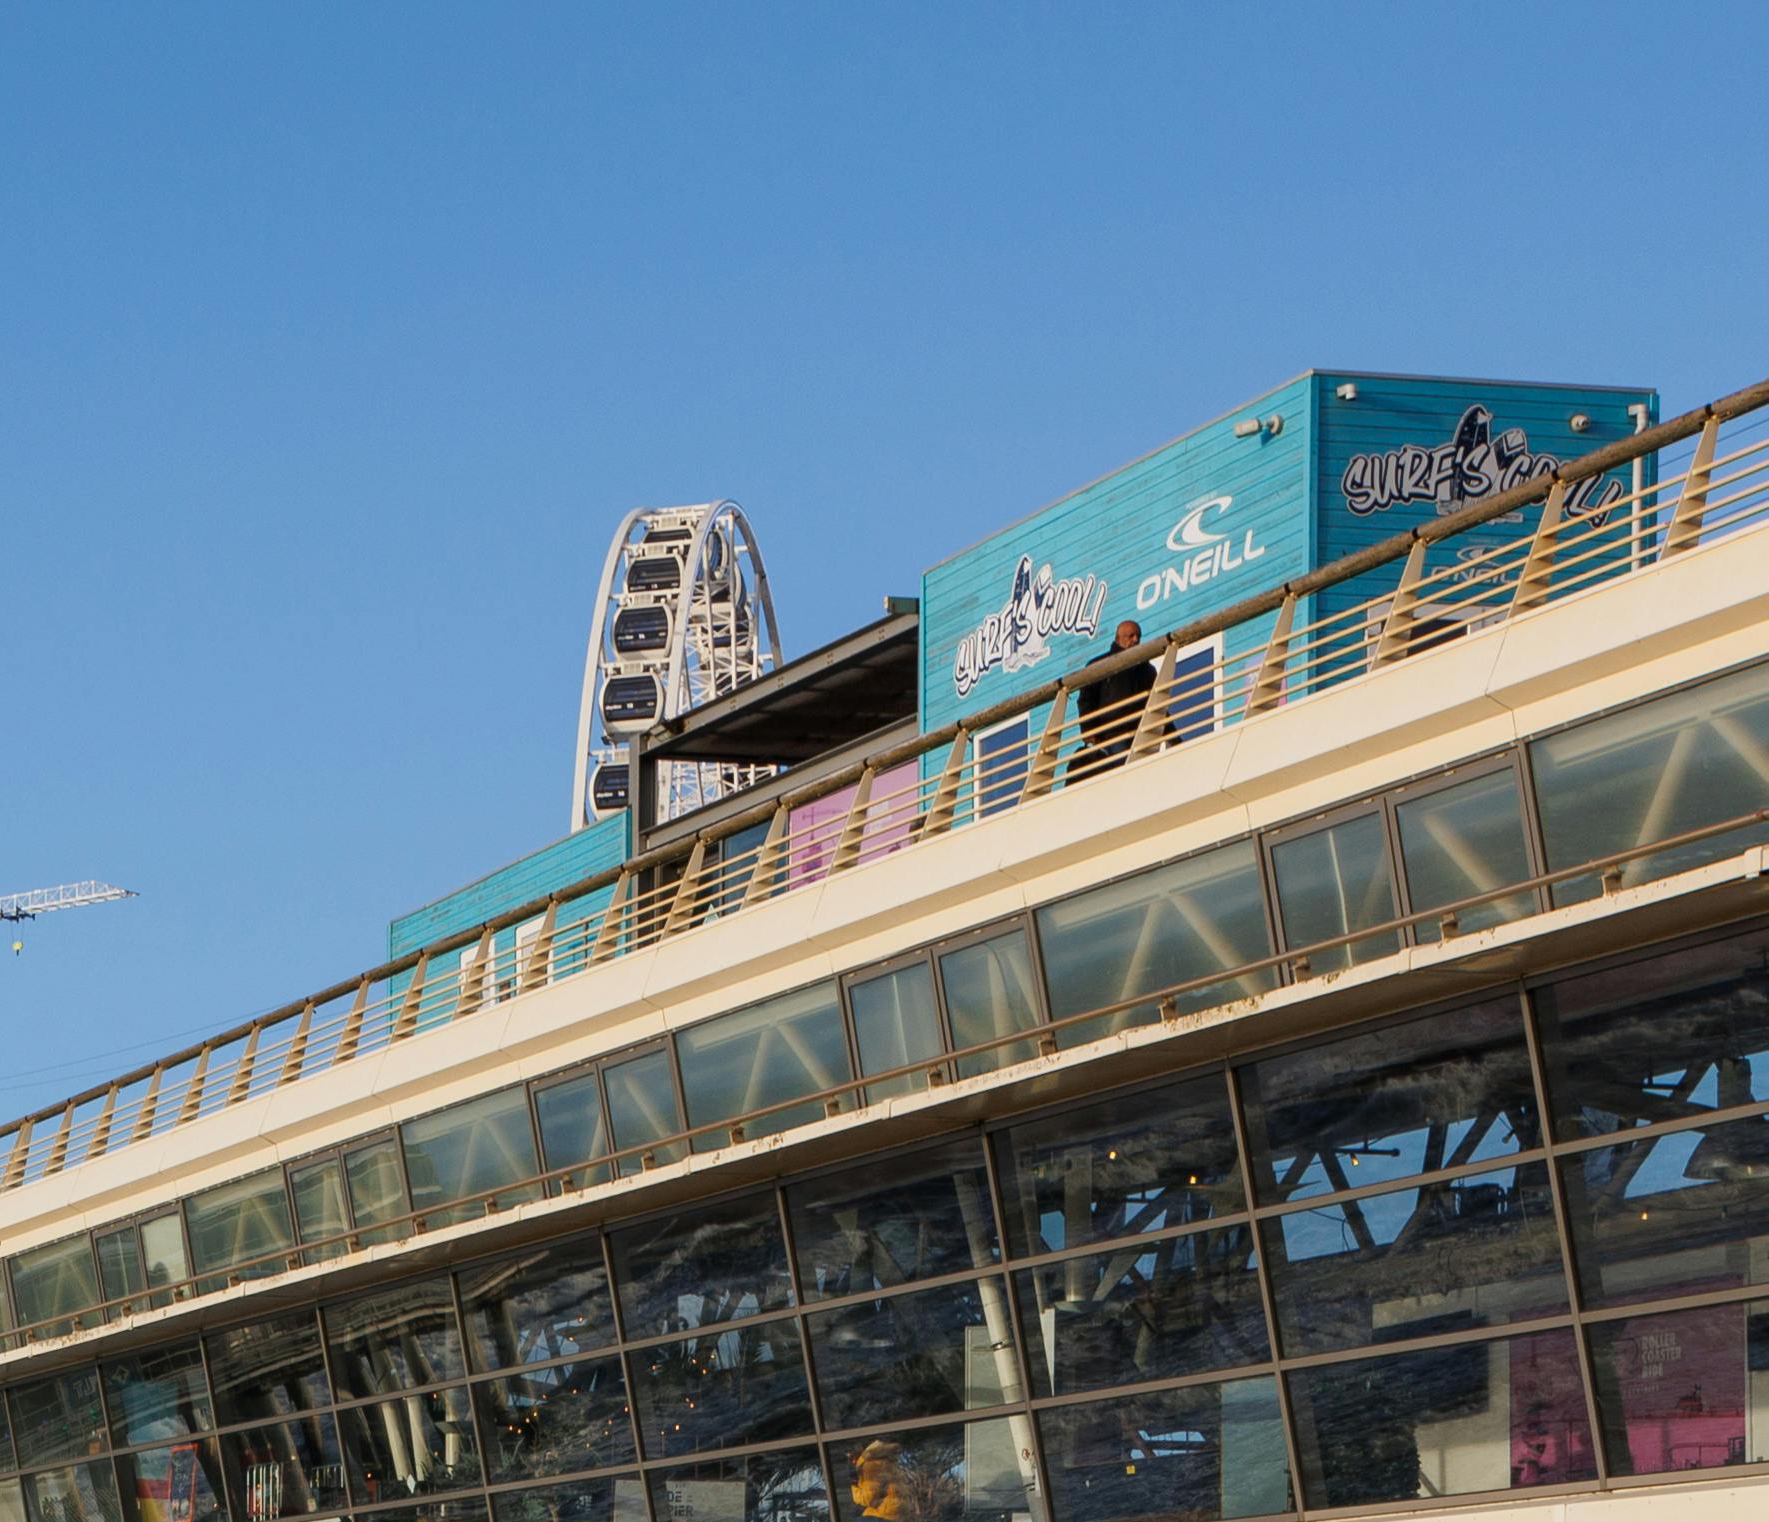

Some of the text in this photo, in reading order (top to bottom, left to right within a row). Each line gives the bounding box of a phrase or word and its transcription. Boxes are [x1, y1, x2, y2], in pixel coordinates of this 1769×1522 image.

[1341, 444, 1624, 529] SURF'S COL!
[1136, 528, 1265, 611] O'NEILL
[954, 572, 1107, 698] SURF'S COOL!
